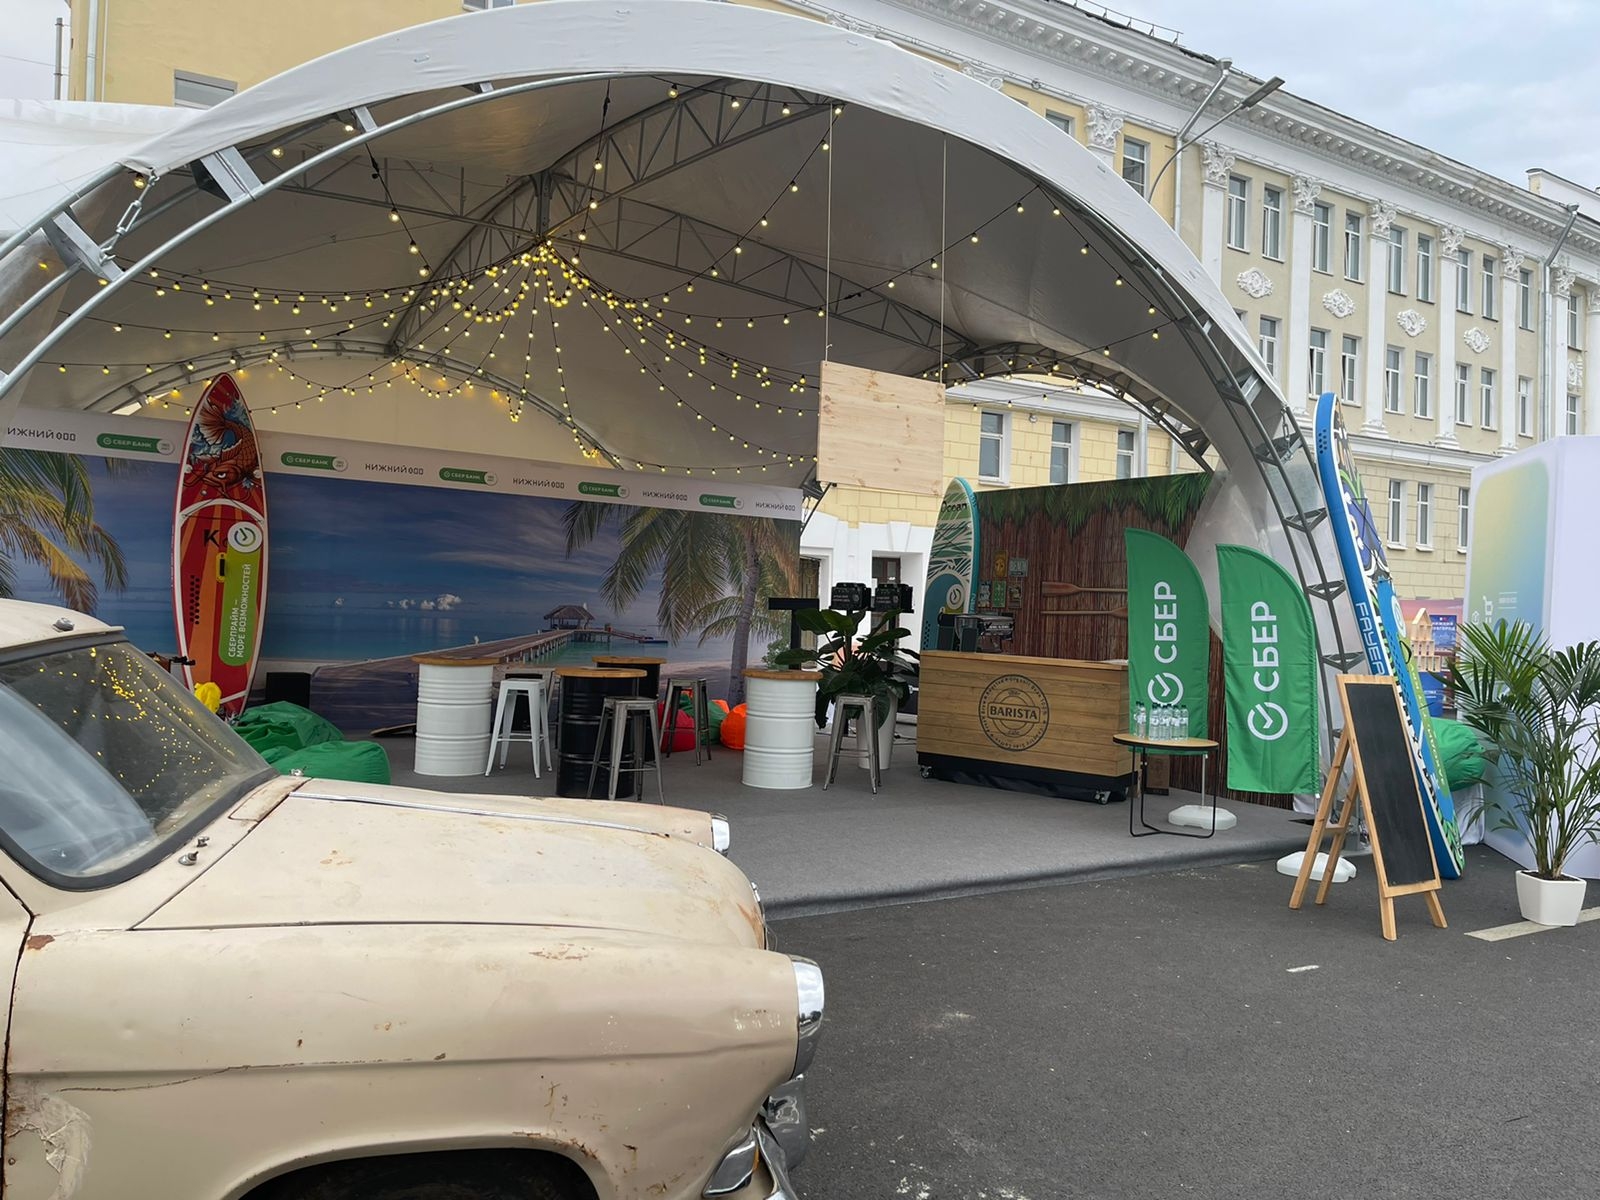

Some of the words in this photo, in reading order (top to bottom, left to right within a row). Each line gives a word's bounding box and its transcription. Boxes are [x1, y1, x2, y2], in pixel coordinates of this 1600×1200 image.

[941, 500, 968, 513] Ocean
[239, 563, 252, 629] ВОЗМОЖНОСТЕЙ
[228, 607, 239, 657] СБЕРПРАЙМ
[237, 631, 246, 658] МОРЕ
[1154, 581, 1178, 664] СБЕР
[1250, 601, 1280, 692] СБЕР
[990, 705, 1037, 720] BARISTA
